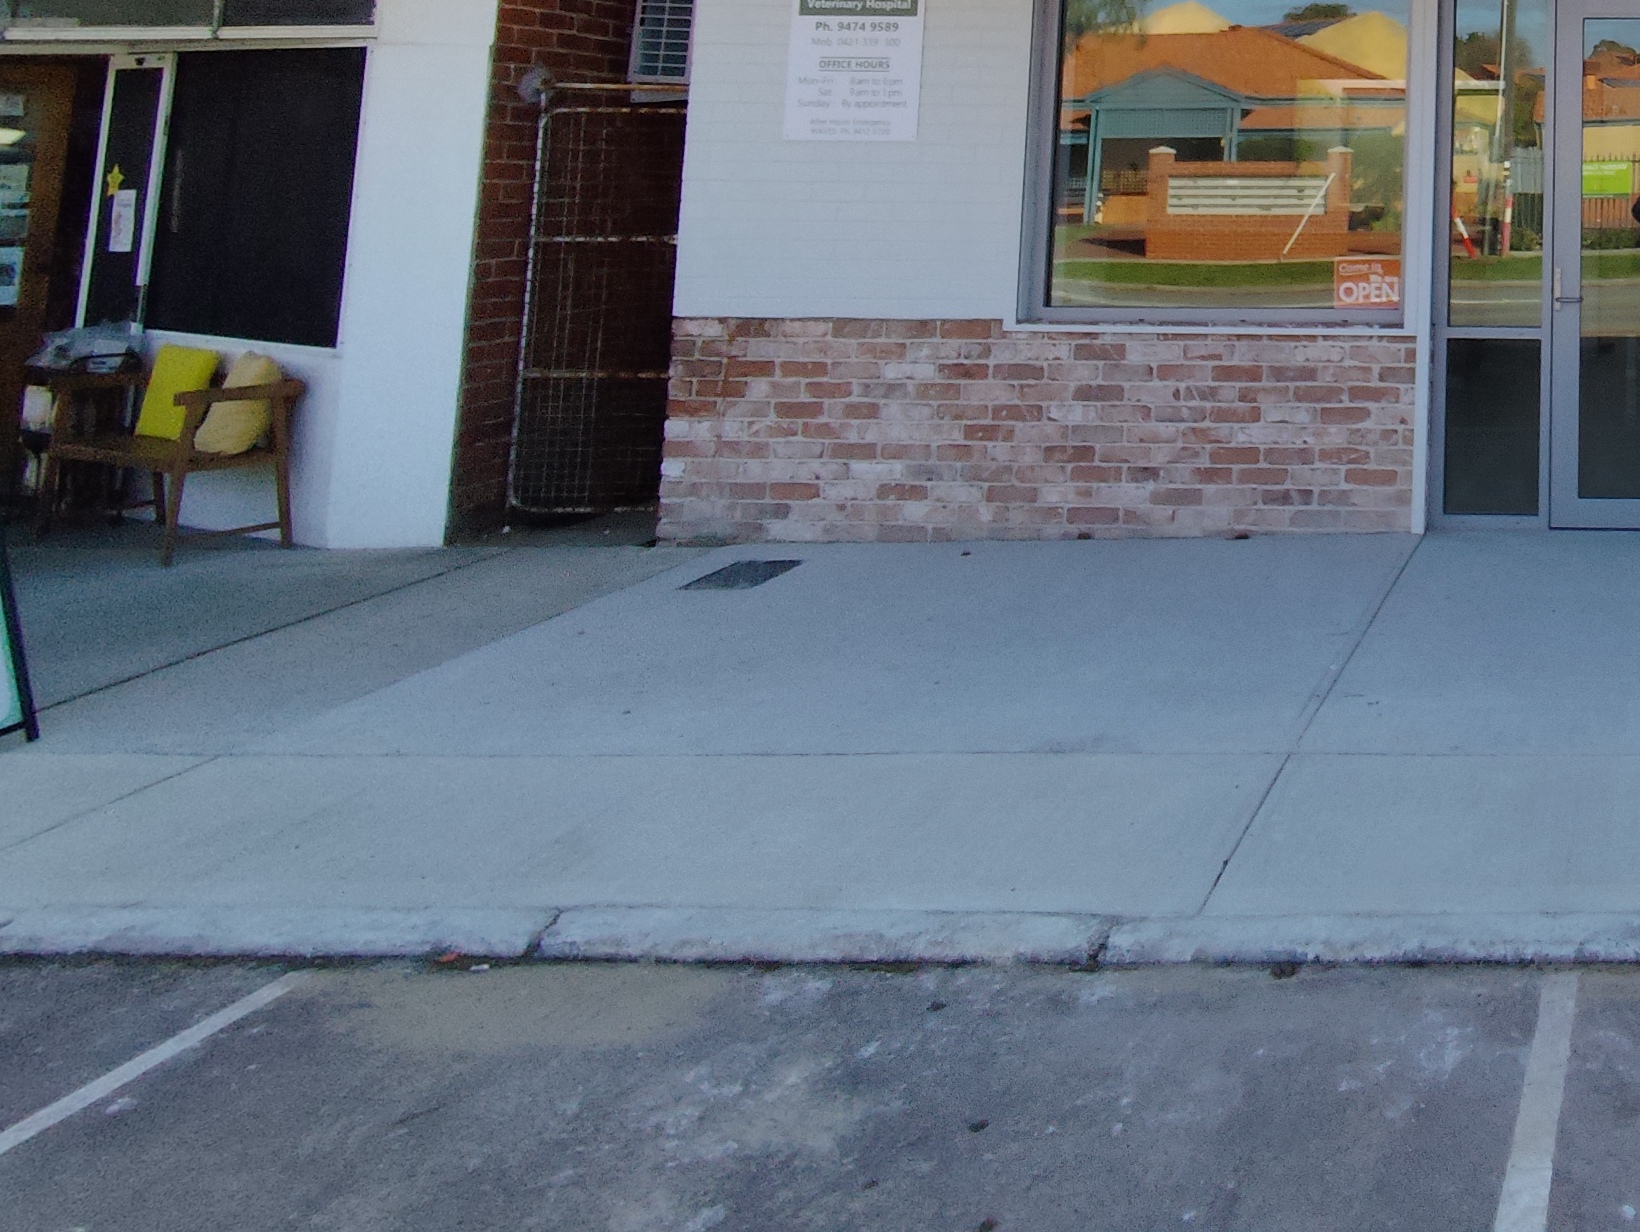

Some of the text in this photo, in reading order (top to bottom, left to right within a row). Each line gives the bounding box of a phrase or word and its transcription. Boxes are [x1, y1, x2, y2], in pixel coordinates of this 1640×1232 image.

[807, 0, 912, 11] Veterinary Hospital
[815, 22, 899, 32] Ph. 9474 9589
[819, 60, 890, 69] OFFICE HOURS
[1339, 281, 1400, 303] OPEN
